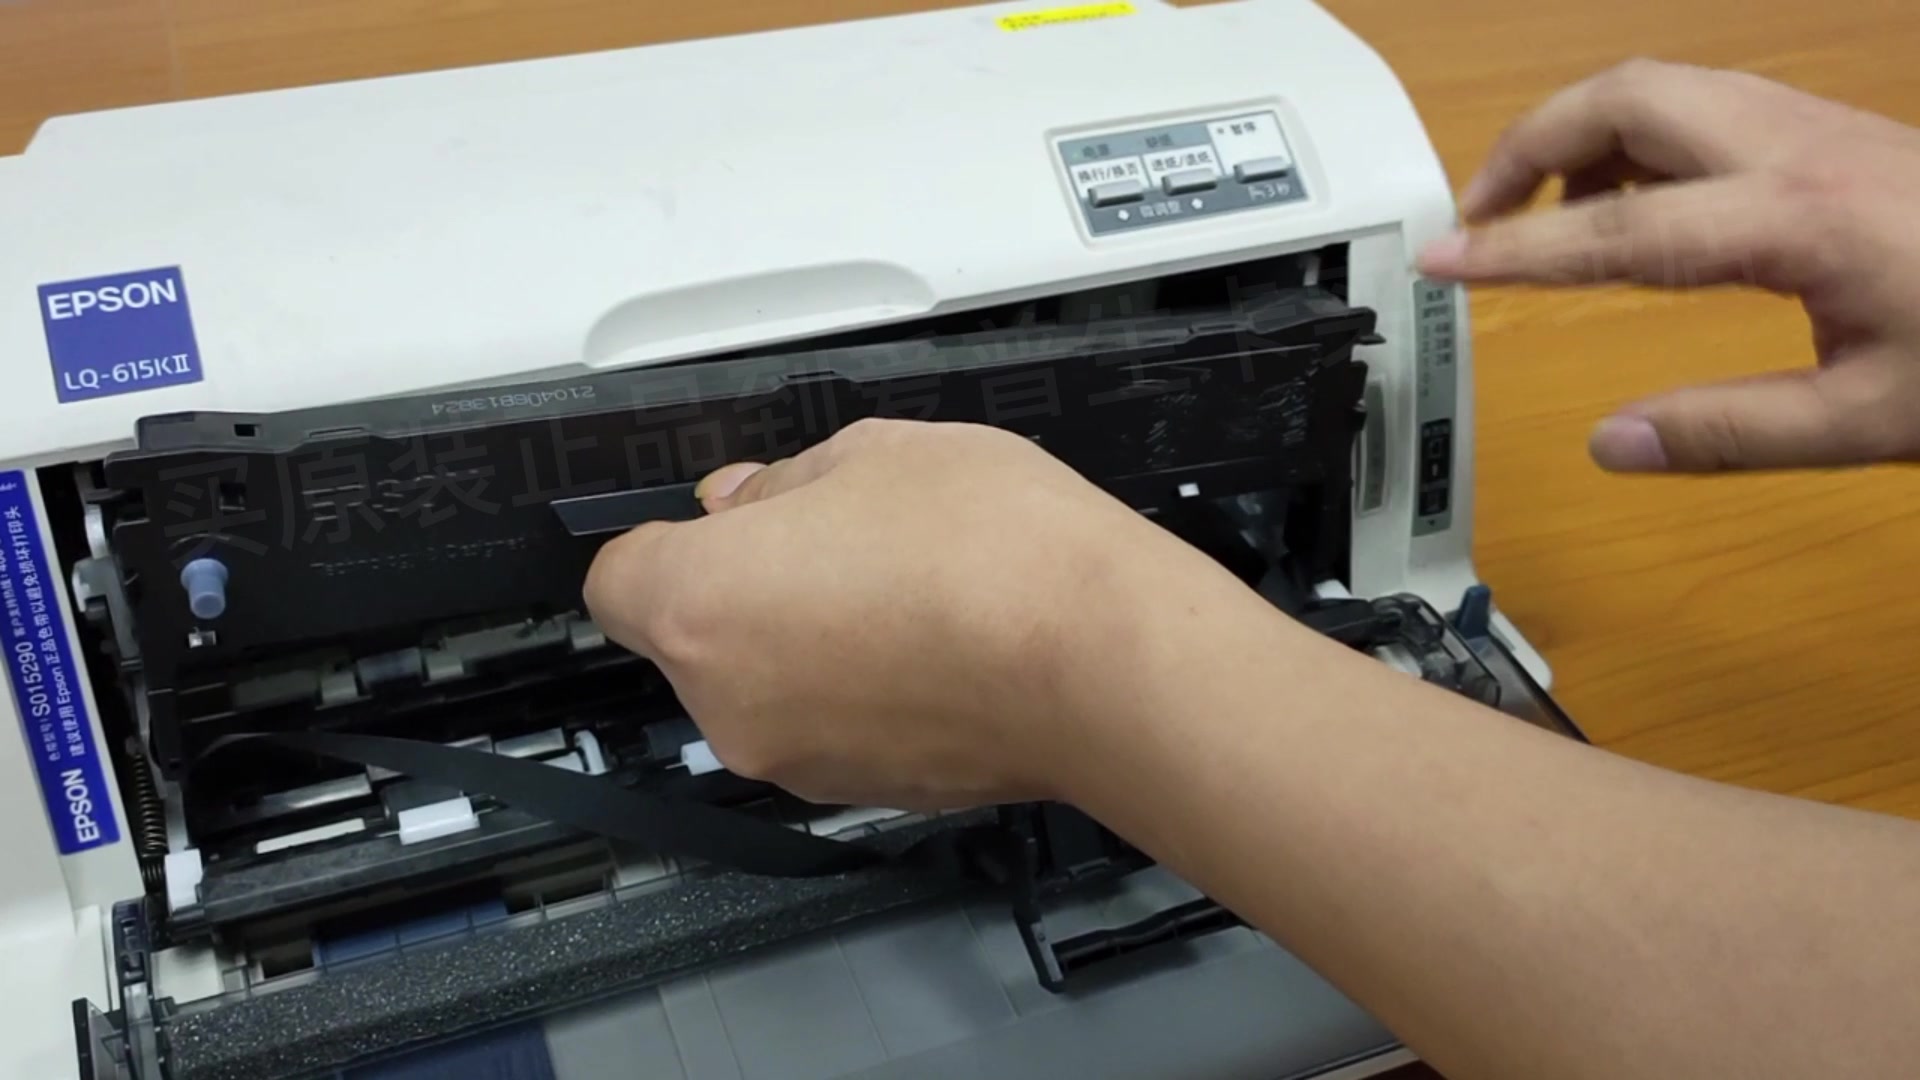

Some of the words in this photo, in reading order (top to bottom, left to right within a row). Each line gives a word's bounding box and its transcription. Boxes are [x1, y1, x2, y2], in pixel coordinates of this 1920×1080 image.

[47, 278, 178, 320] EPSON
[15, 641, 51, 718] S015290
[52, 666, 71, 705] Epson
[58, 705, 86, 757] 建议使用
[60, 767, 101, 844] EPSON
